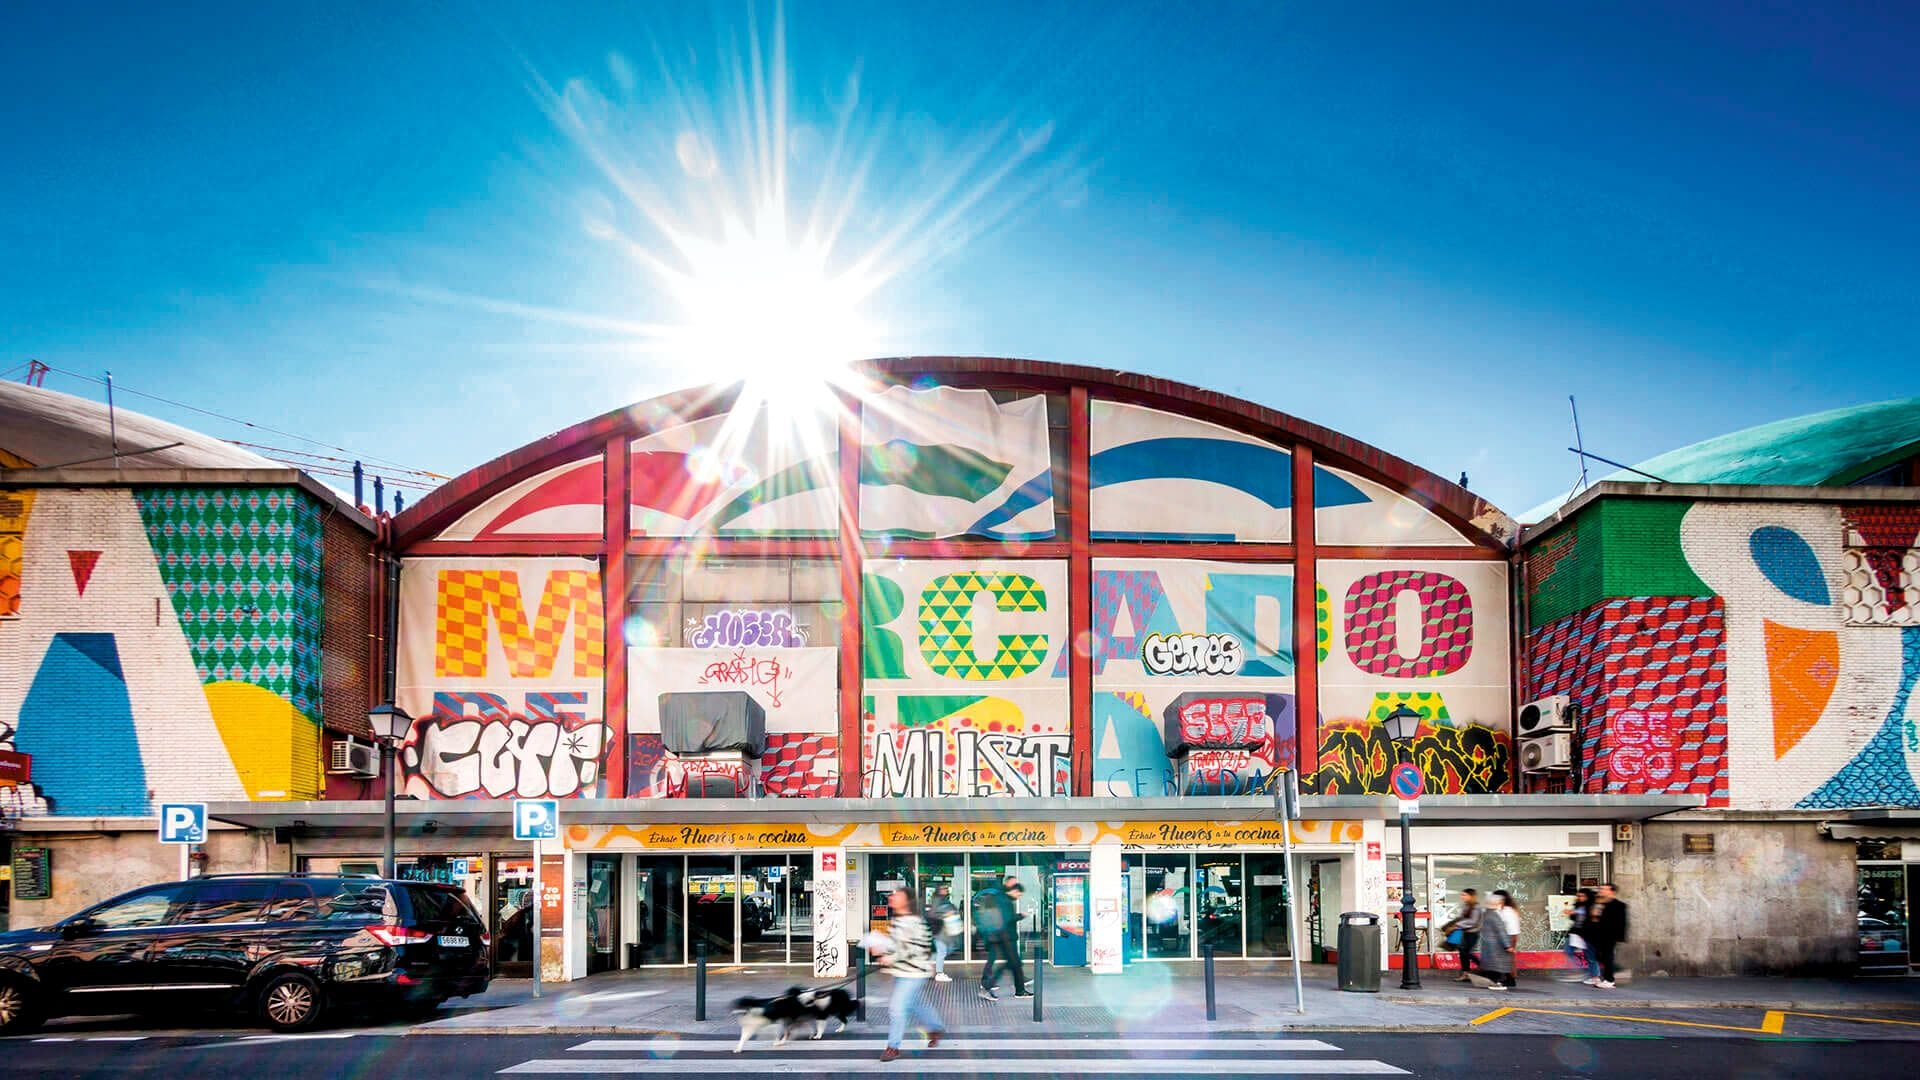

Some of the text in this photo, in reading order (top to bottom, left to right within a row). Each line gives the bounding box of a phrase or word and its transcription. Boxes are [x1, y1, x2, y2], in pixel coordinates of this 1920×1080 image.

[166, 807, 195, 839] P
[520, 804, 548, 836] P
[680, 826, 737, 845] Huevos
[758, 829, 809, 844] cocina
[922, 825, 977, 843] Huevos
[999, 827, 1048, 842] cocina
[1159, 824, 1212, 841] Huevos
[1234, 825, 1281, 840] cocina
[543, 893, 561, 901] QUE
